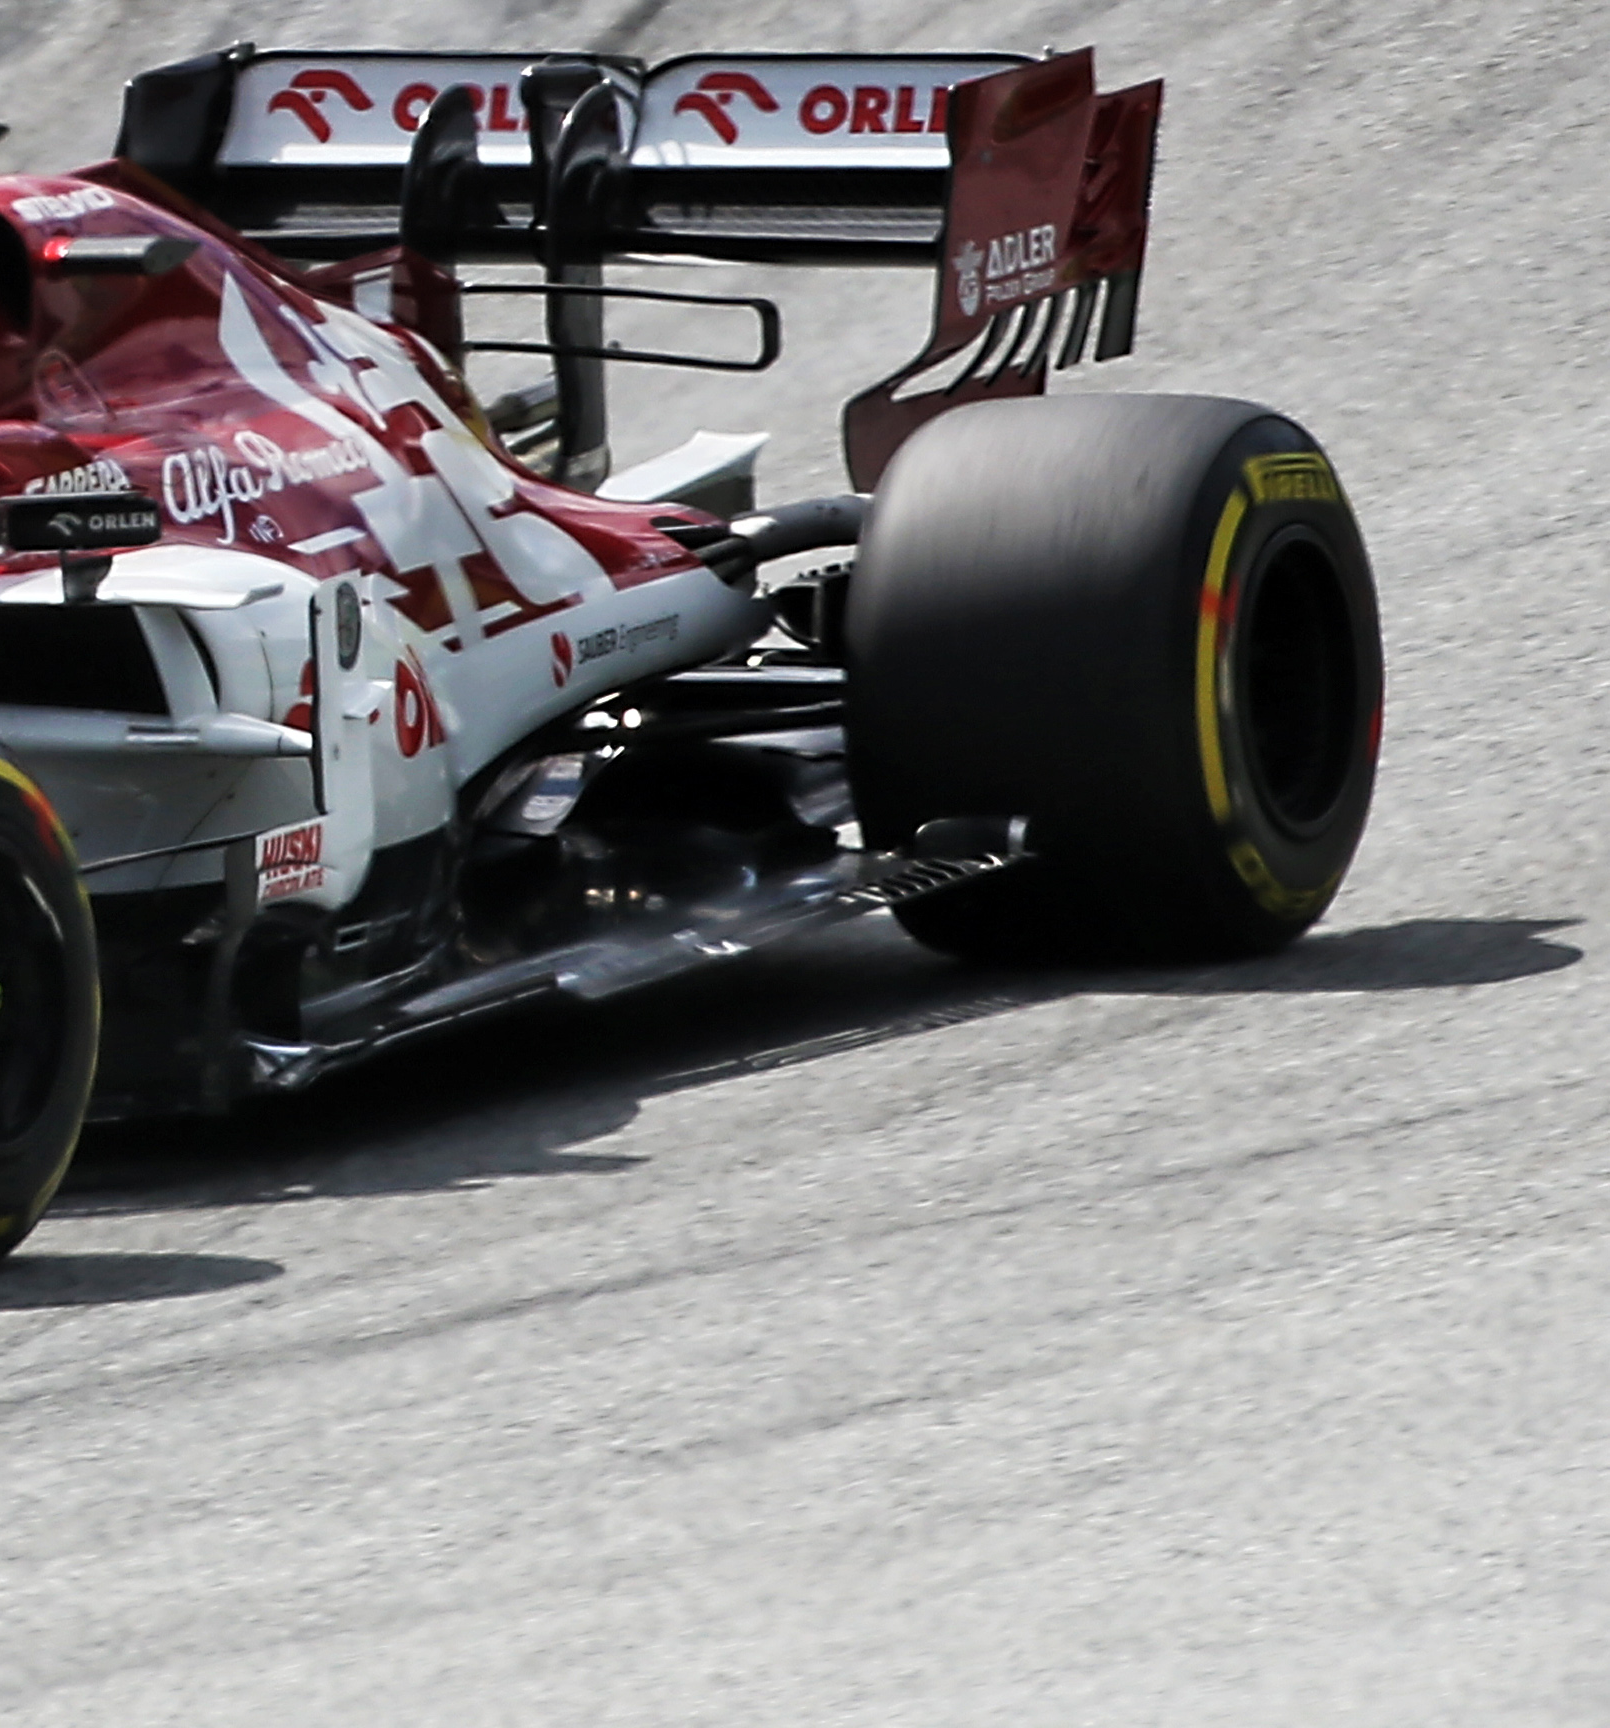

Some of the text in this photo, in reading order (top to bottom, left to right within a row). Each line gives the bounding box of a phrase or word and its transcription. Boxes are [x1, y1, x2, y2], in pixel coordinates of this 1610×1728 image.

[985, 224, 1056, 279] ADLER
[162, 430, 369, 545] Alfa Romeo
[89, 513, 156, 531] ORLEN
